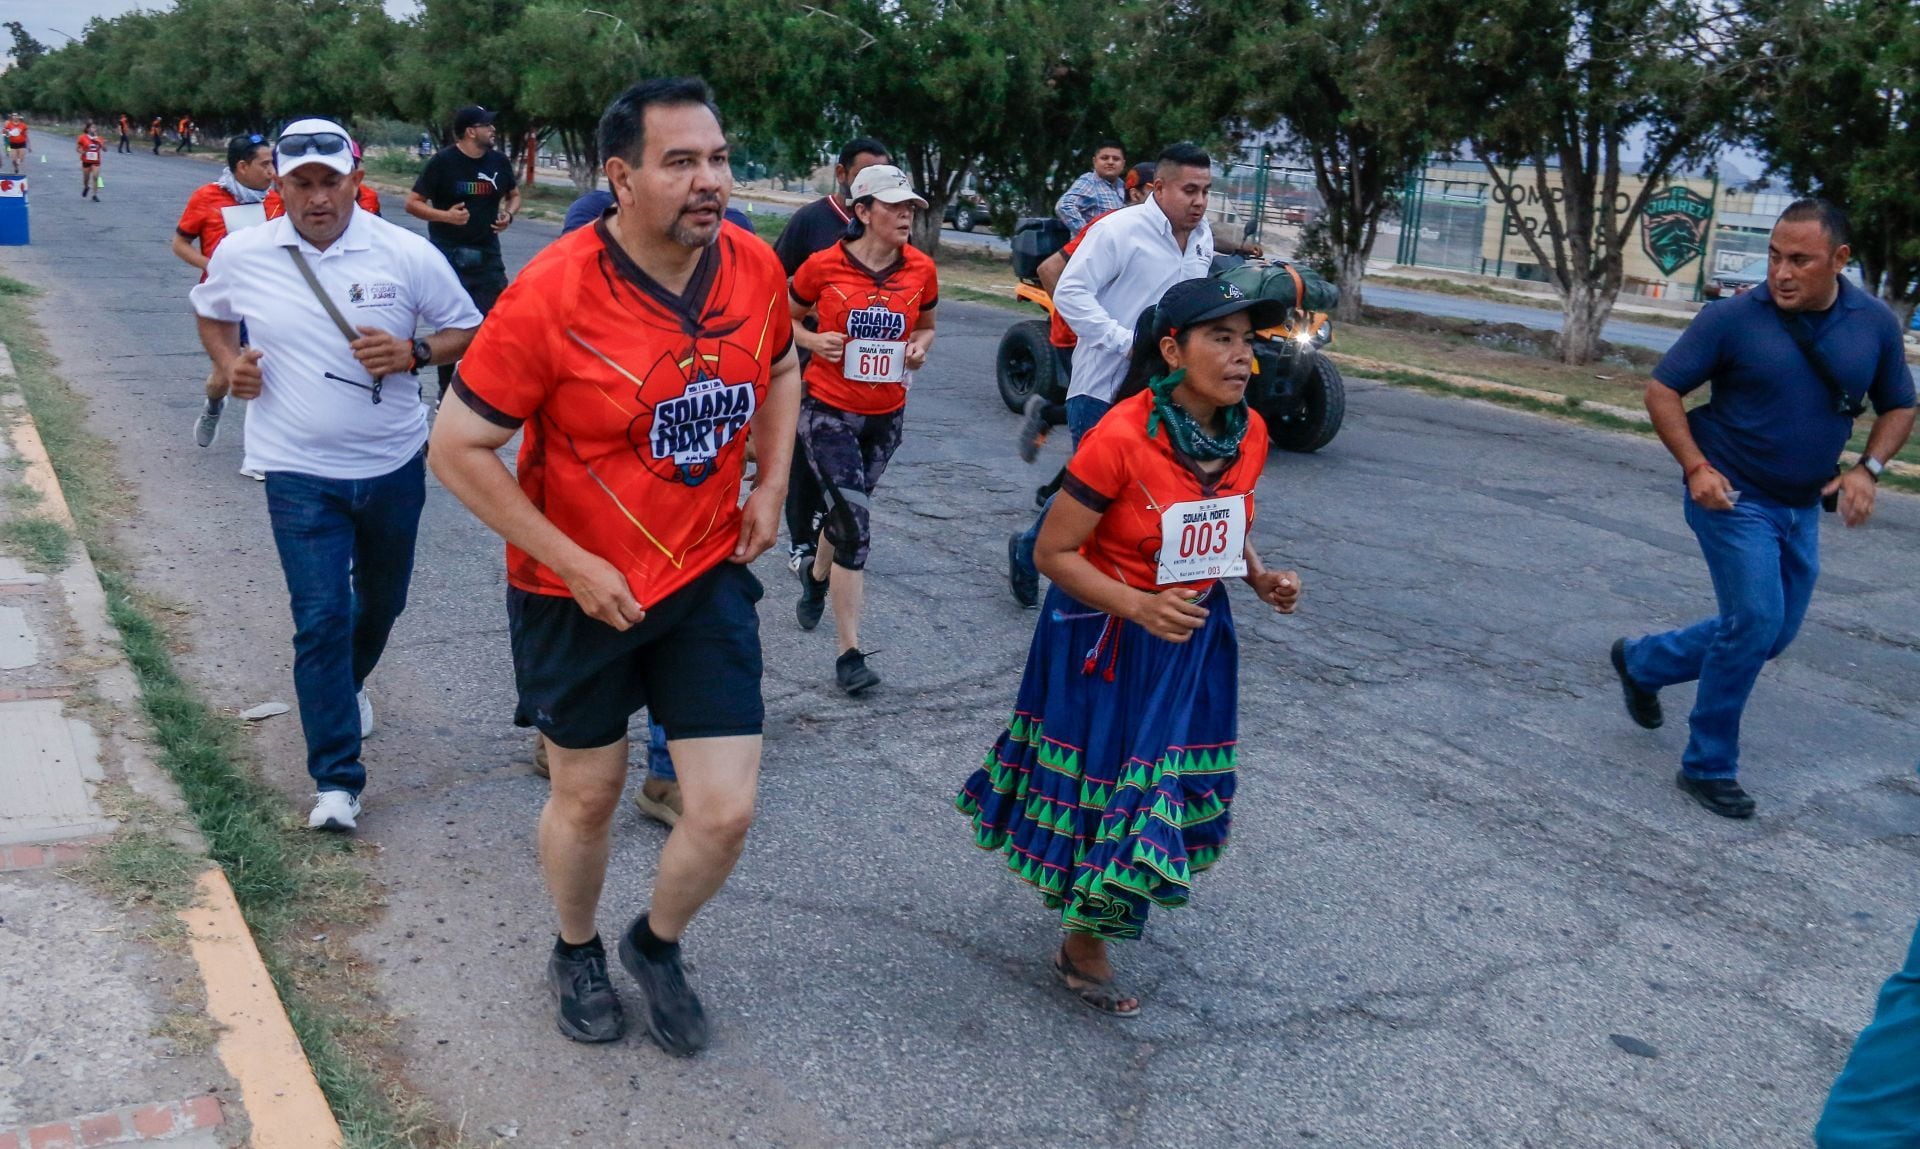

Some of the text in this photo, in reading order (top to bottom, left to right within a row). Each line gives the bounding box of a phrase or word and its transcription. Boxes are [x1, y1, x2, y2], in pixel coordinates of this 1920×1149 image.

[851, 310, 902, 328] SOLANA
[851, 325, 901, 339] NORTE
[860, 354, 890, 376] 610
[658, 387, 749, 429] SOLANA
[1183, 509, 1230, 523] SOLANA NORTE
[1179, 520, 1228, 558] 003
[1208, 566, 1220, 575] 003
